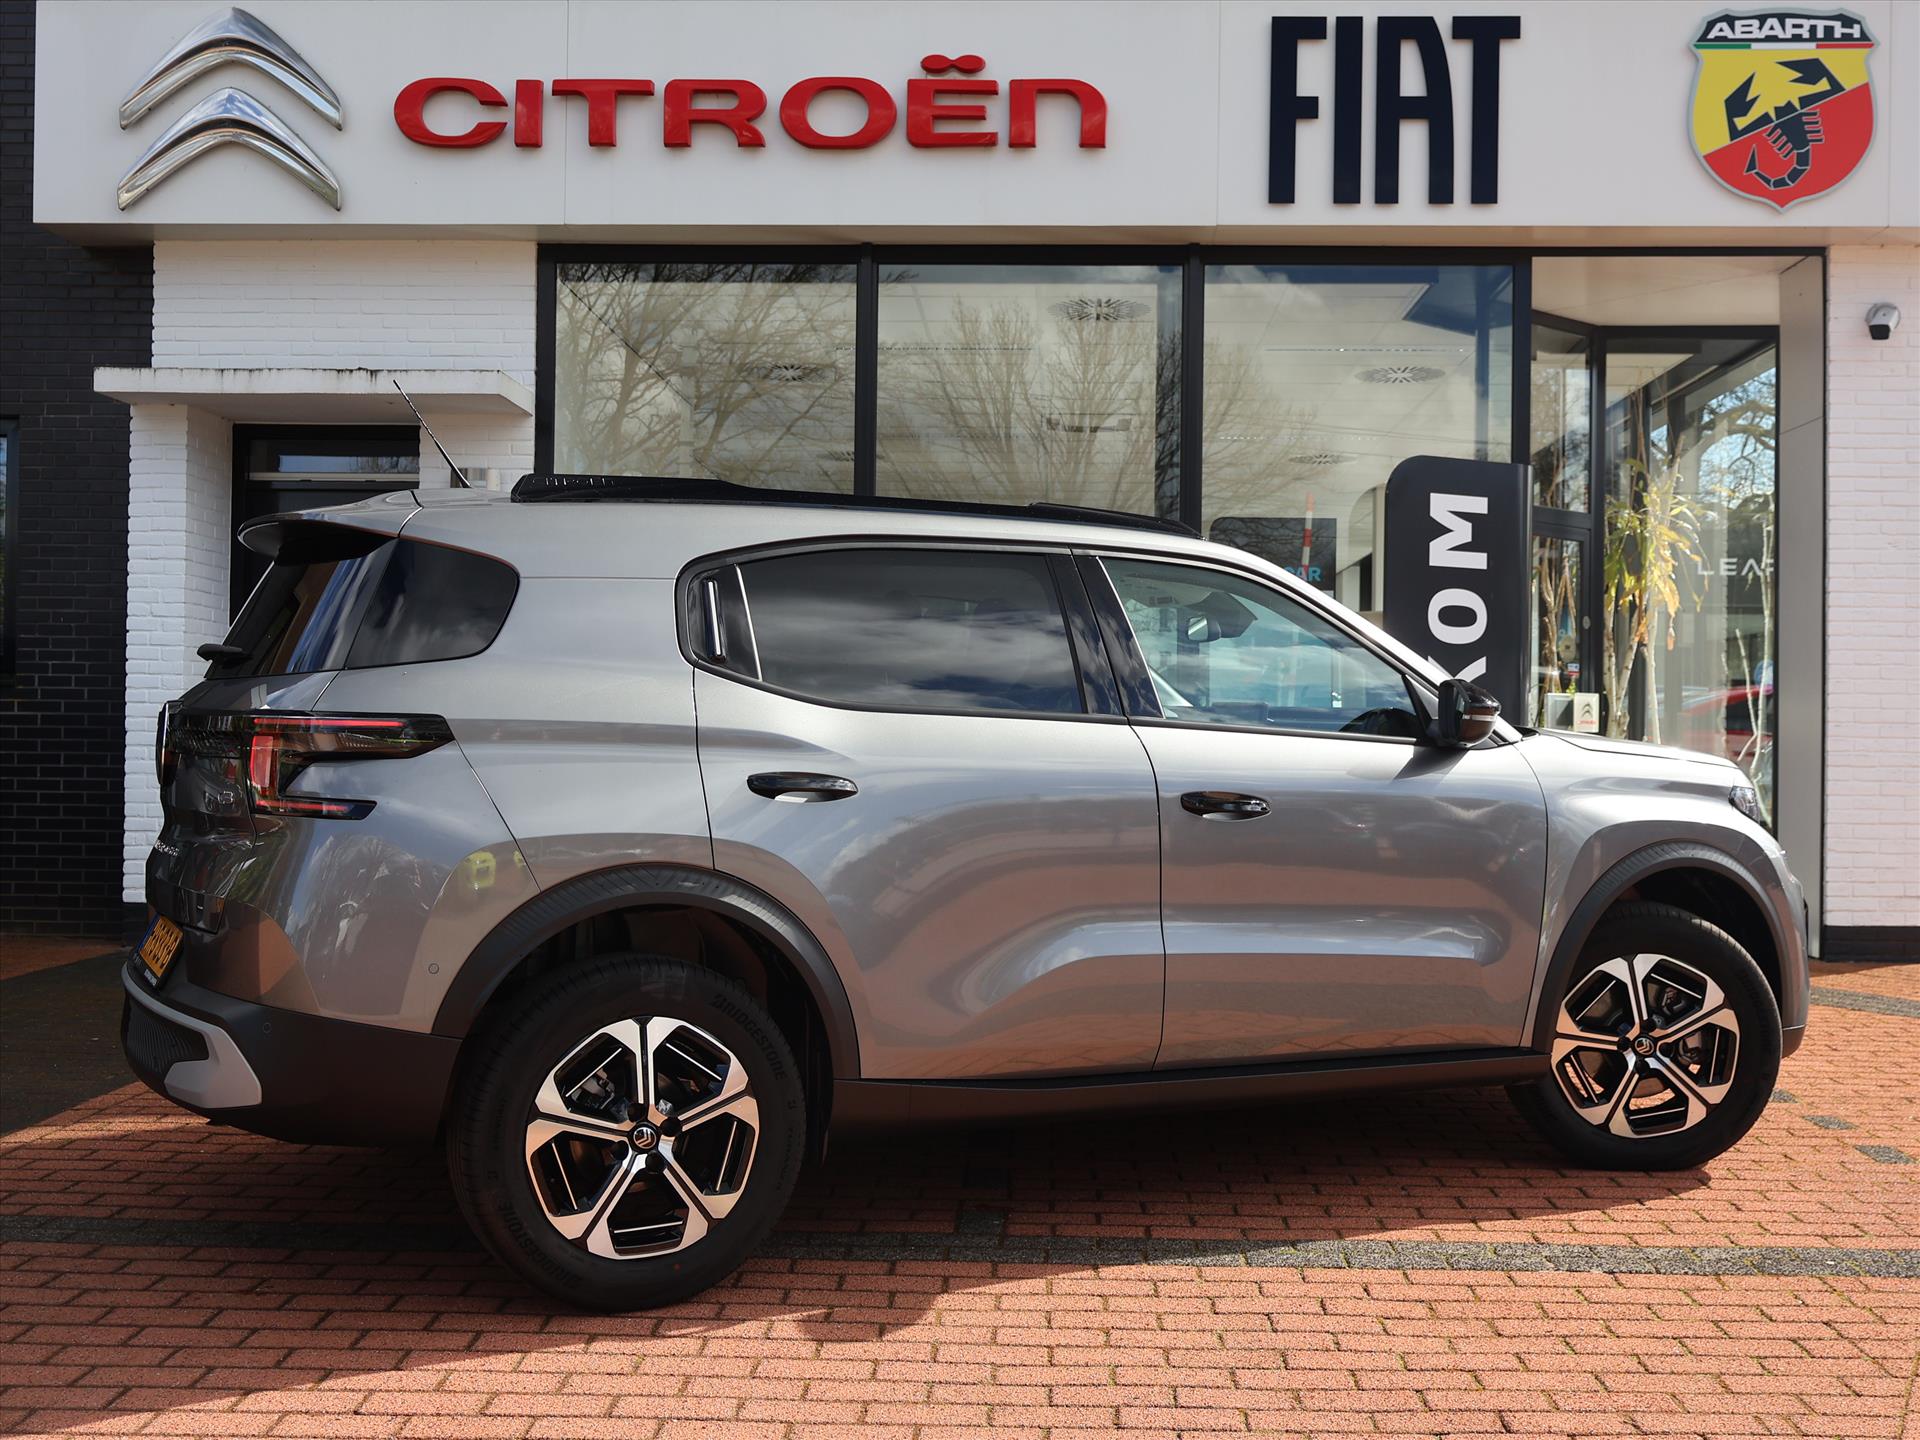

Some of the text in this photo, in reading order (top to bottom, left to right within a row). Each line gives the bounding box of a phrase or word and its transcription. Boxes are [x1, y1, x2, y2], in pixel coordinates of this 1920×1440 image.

[1706, 17, 1861, 39] ABARTH
[393, 53, 1107, 149] CITROËN
[1268, 15, 1521, 204] FIAT
[708, 992, 788, 1081] BRIDGESTONE
